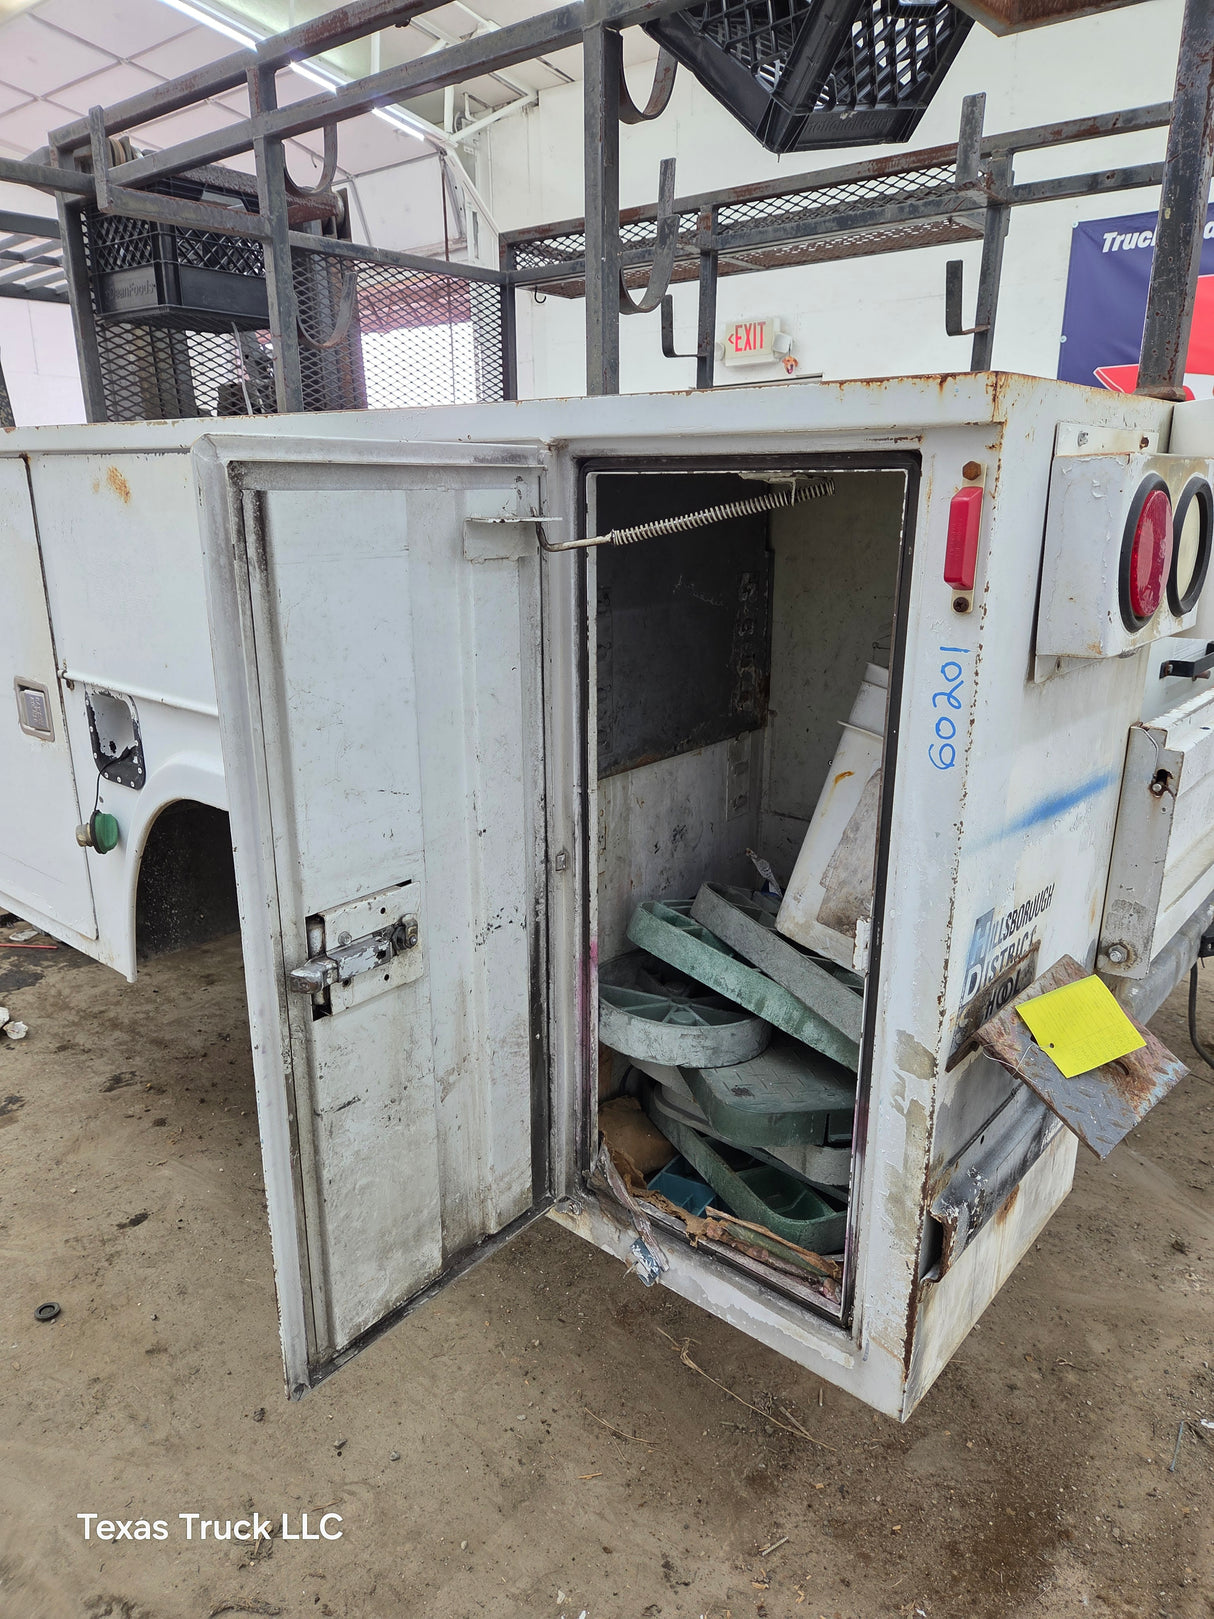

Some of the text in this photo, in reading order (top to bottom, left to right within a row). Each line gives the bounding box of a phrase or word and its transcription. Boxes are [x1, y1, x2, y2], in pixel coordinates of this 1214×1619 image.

[735, 321, 766, 353] EXIT
[928, 645, 971, 770] 60201
[968, 882, 1056, 965] HILLSBOROUGH
